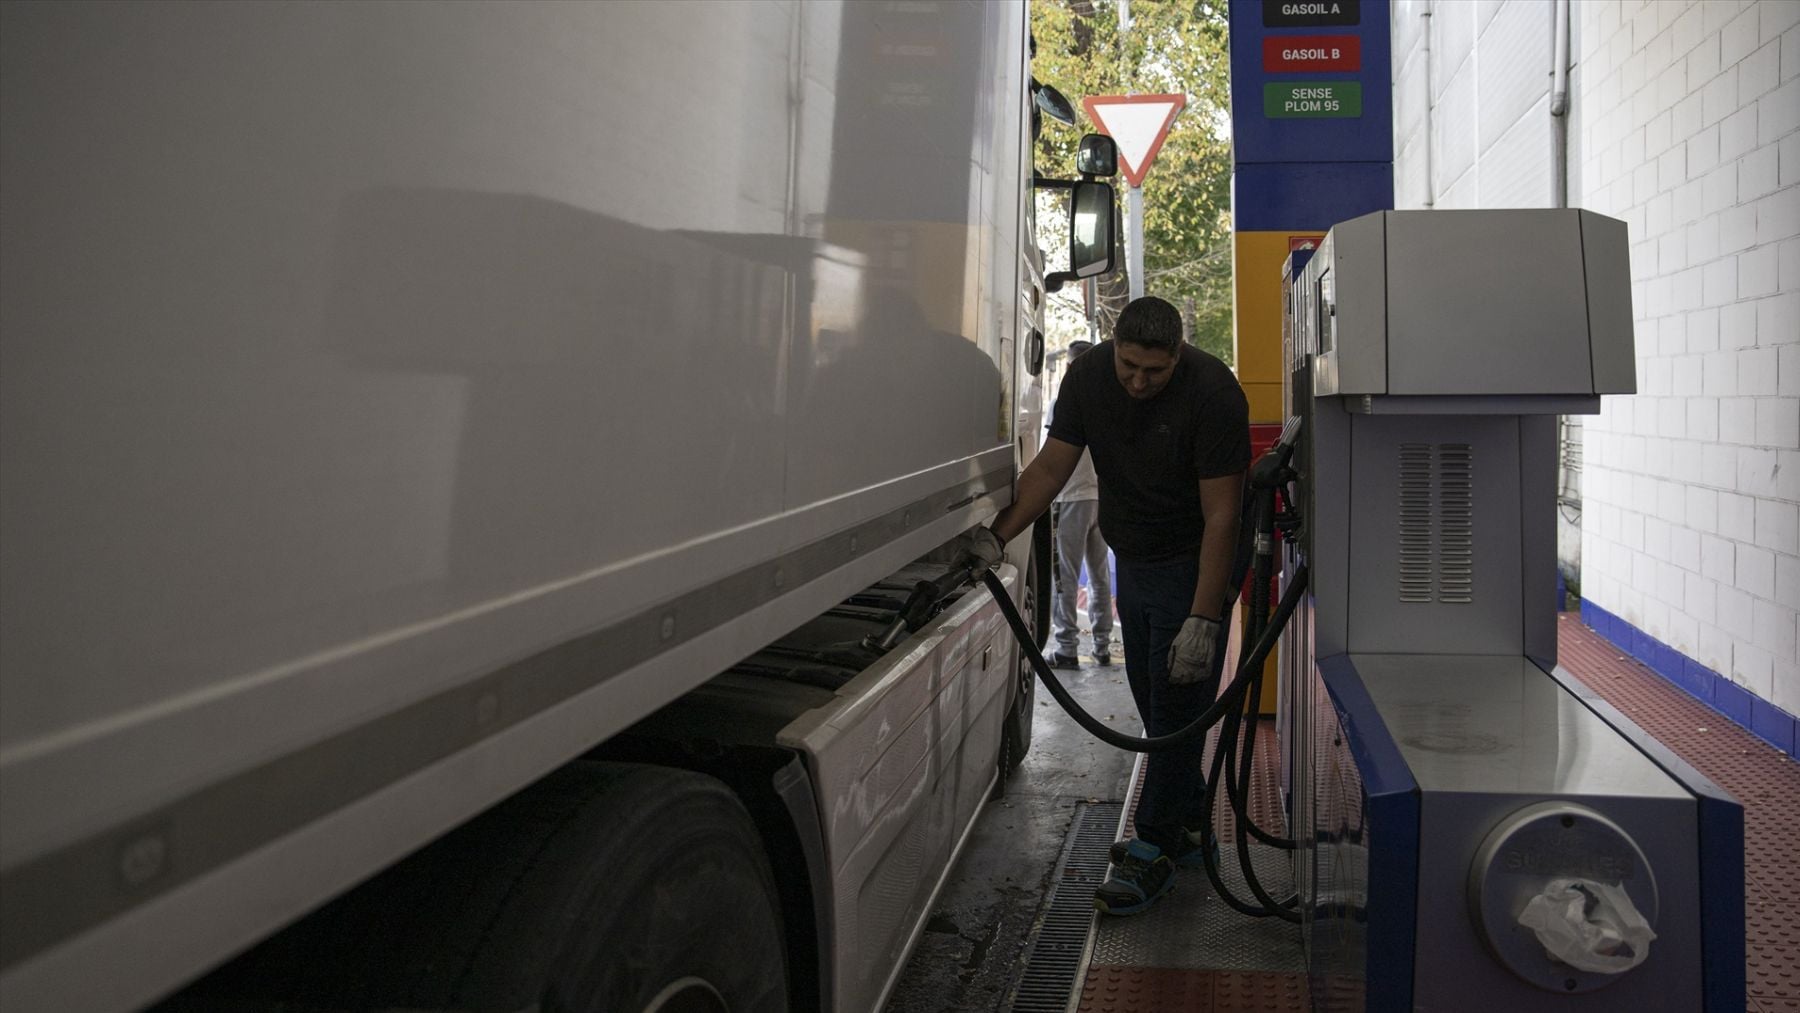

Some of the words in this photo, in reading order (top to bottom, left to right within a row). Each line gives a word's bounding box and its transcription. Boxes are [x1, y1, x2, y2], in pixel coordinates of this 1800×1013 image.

[1282, 3, 1328, 15] GASOIL
[1331, 3, 1340, 14] A
[1282, 48, 1329, 60] GASOIL
[1331, 48, 1340, 60] B
[1291, 88, 1333, 99] SENSE
[1285, 101, 1321, 112] PLOM
[1324, 100, 1340, 111] 95
